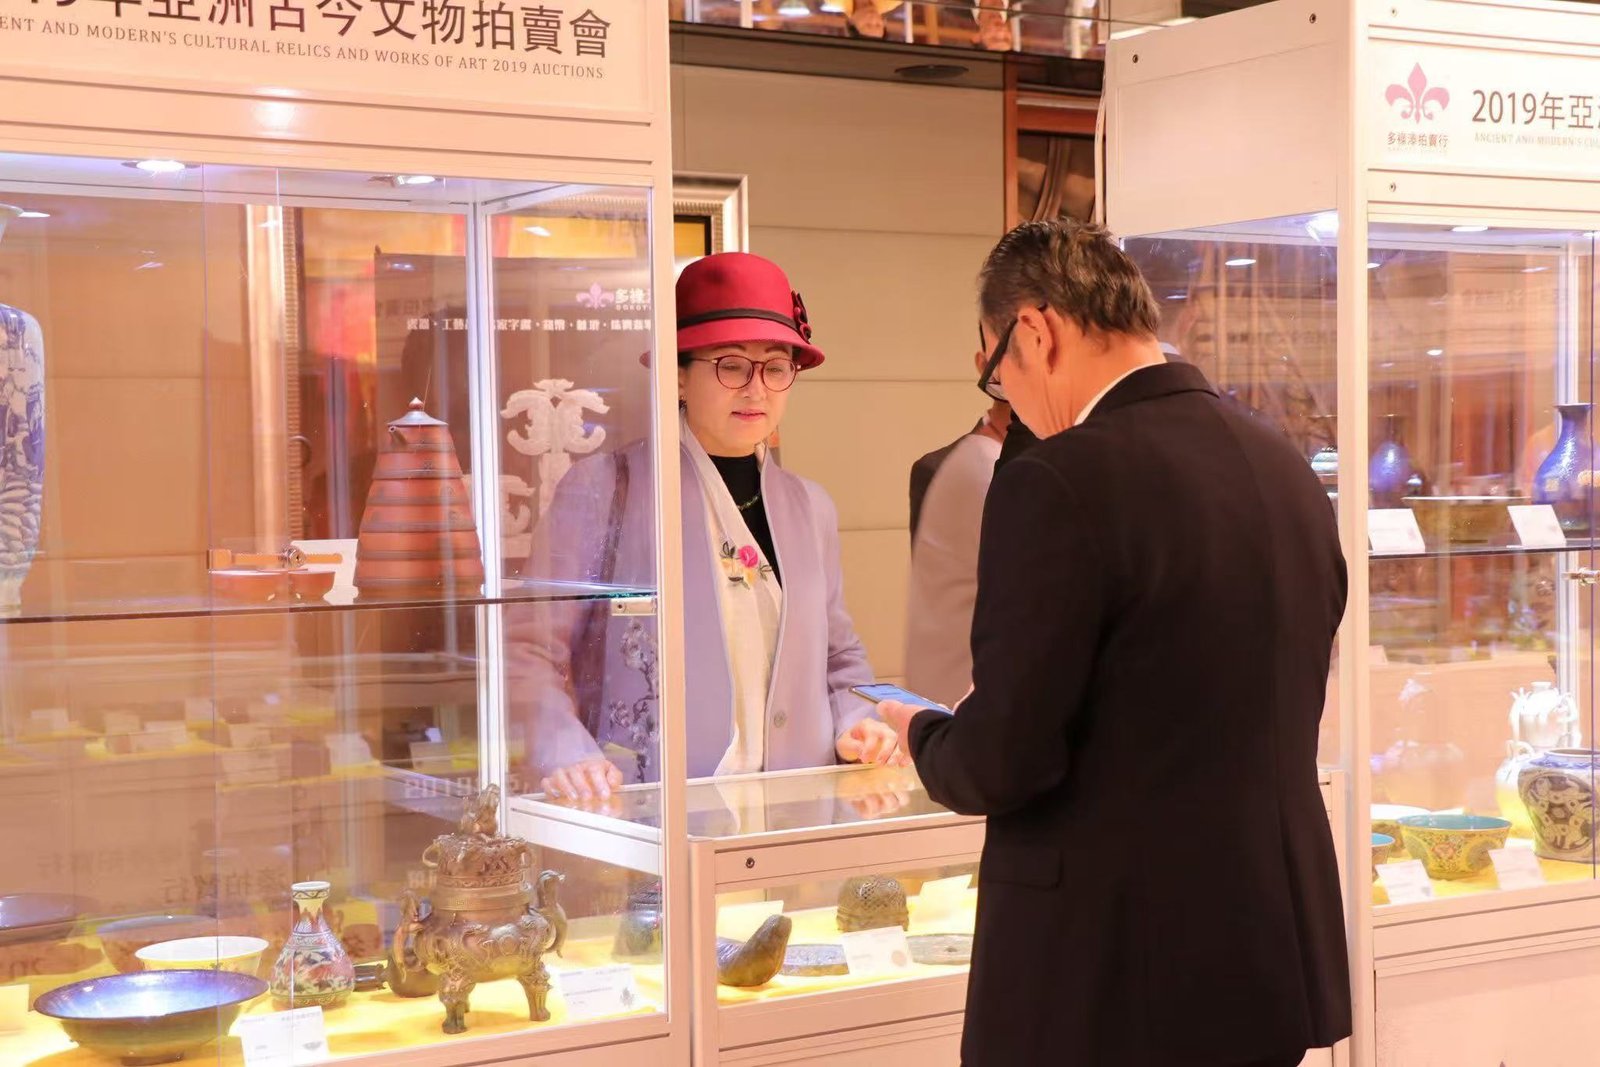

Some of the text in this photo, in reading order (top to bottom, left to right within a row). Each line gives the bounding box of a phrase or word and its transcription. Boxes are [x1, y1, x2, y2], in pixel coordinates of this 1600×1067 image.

[42, 20, 79, 36] AND
[87, 24, 177, 45] MODERN'S
[183, 33, 271, 53] CULTURAL
[276, 41, 331, 59] RELICS
[336, 47, 369, 61] AND
[375, 50, 429, 67] WORKS
[434, 54, 453, 68] OF
[458, 57, 488, 71] ART
[493, 59, 527, 73] 2019
[532, 63, 604, 79] AUCTIONS
[1472, 89, 1600, 130] 2019年亞
